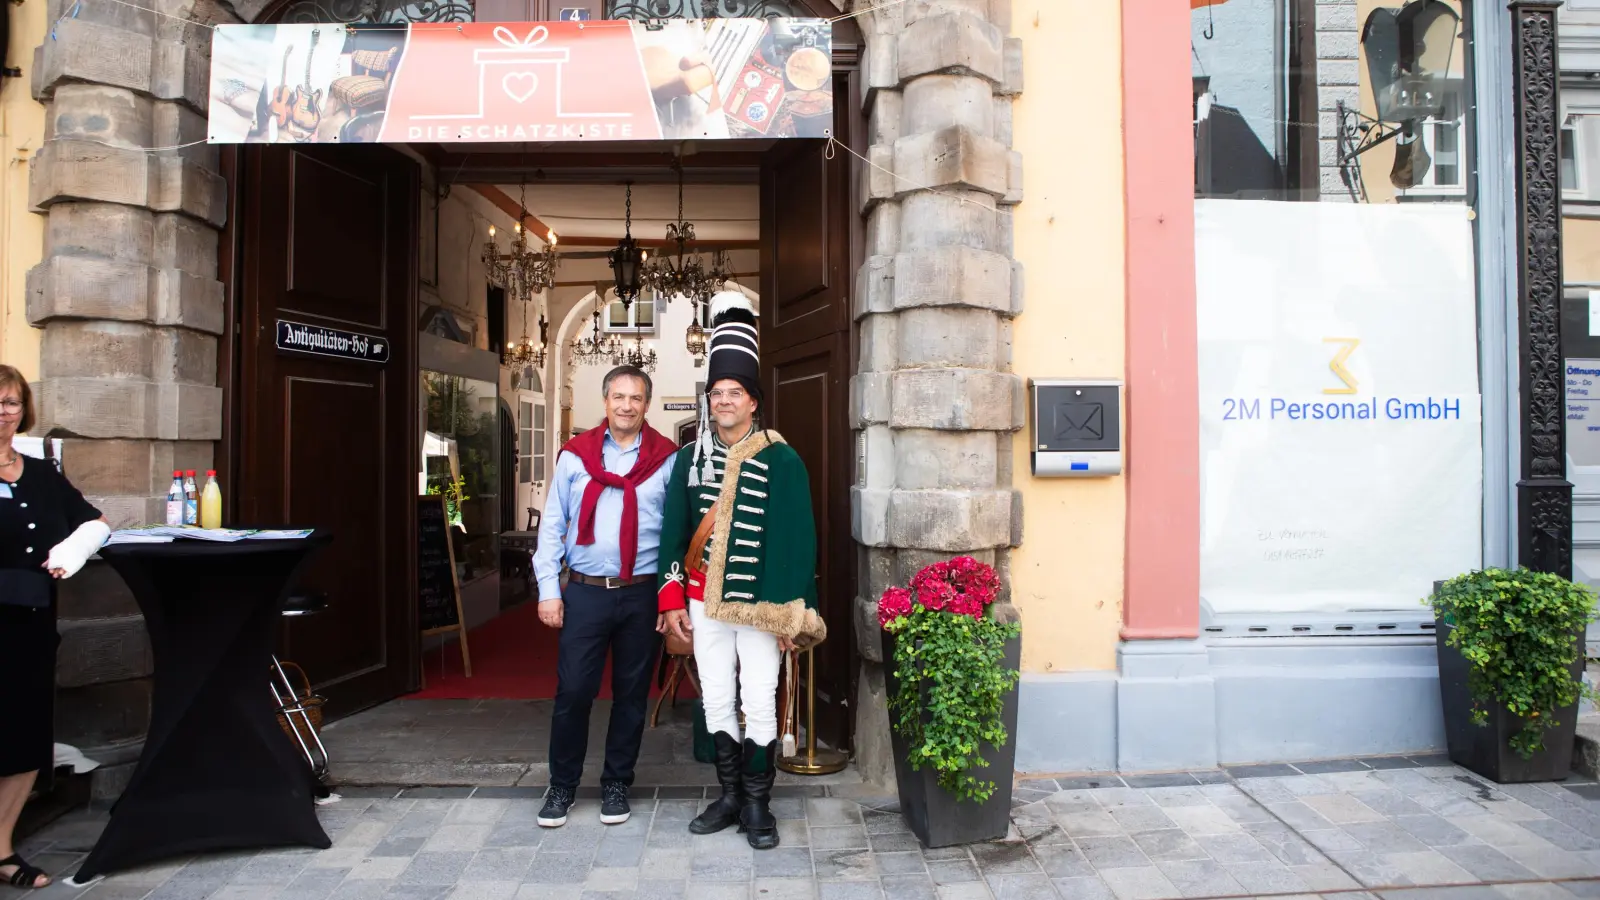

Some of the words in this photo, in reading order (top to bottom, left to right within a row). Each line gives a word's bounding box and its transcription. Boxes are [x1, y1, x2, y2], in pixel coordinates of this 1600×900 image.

[569, 9, 580, 22] 4
[408, 125, 449, 140] DIE
[461, 123, 633, 139] SCHATZKISTE
[284, 323, 369, 357] Antiquitäten-Hof
[1222, 397, 1261, 421] 2M
[1270, 396, 1377, 420] Personal
[1385, 396, 1460, 420] GmbH
